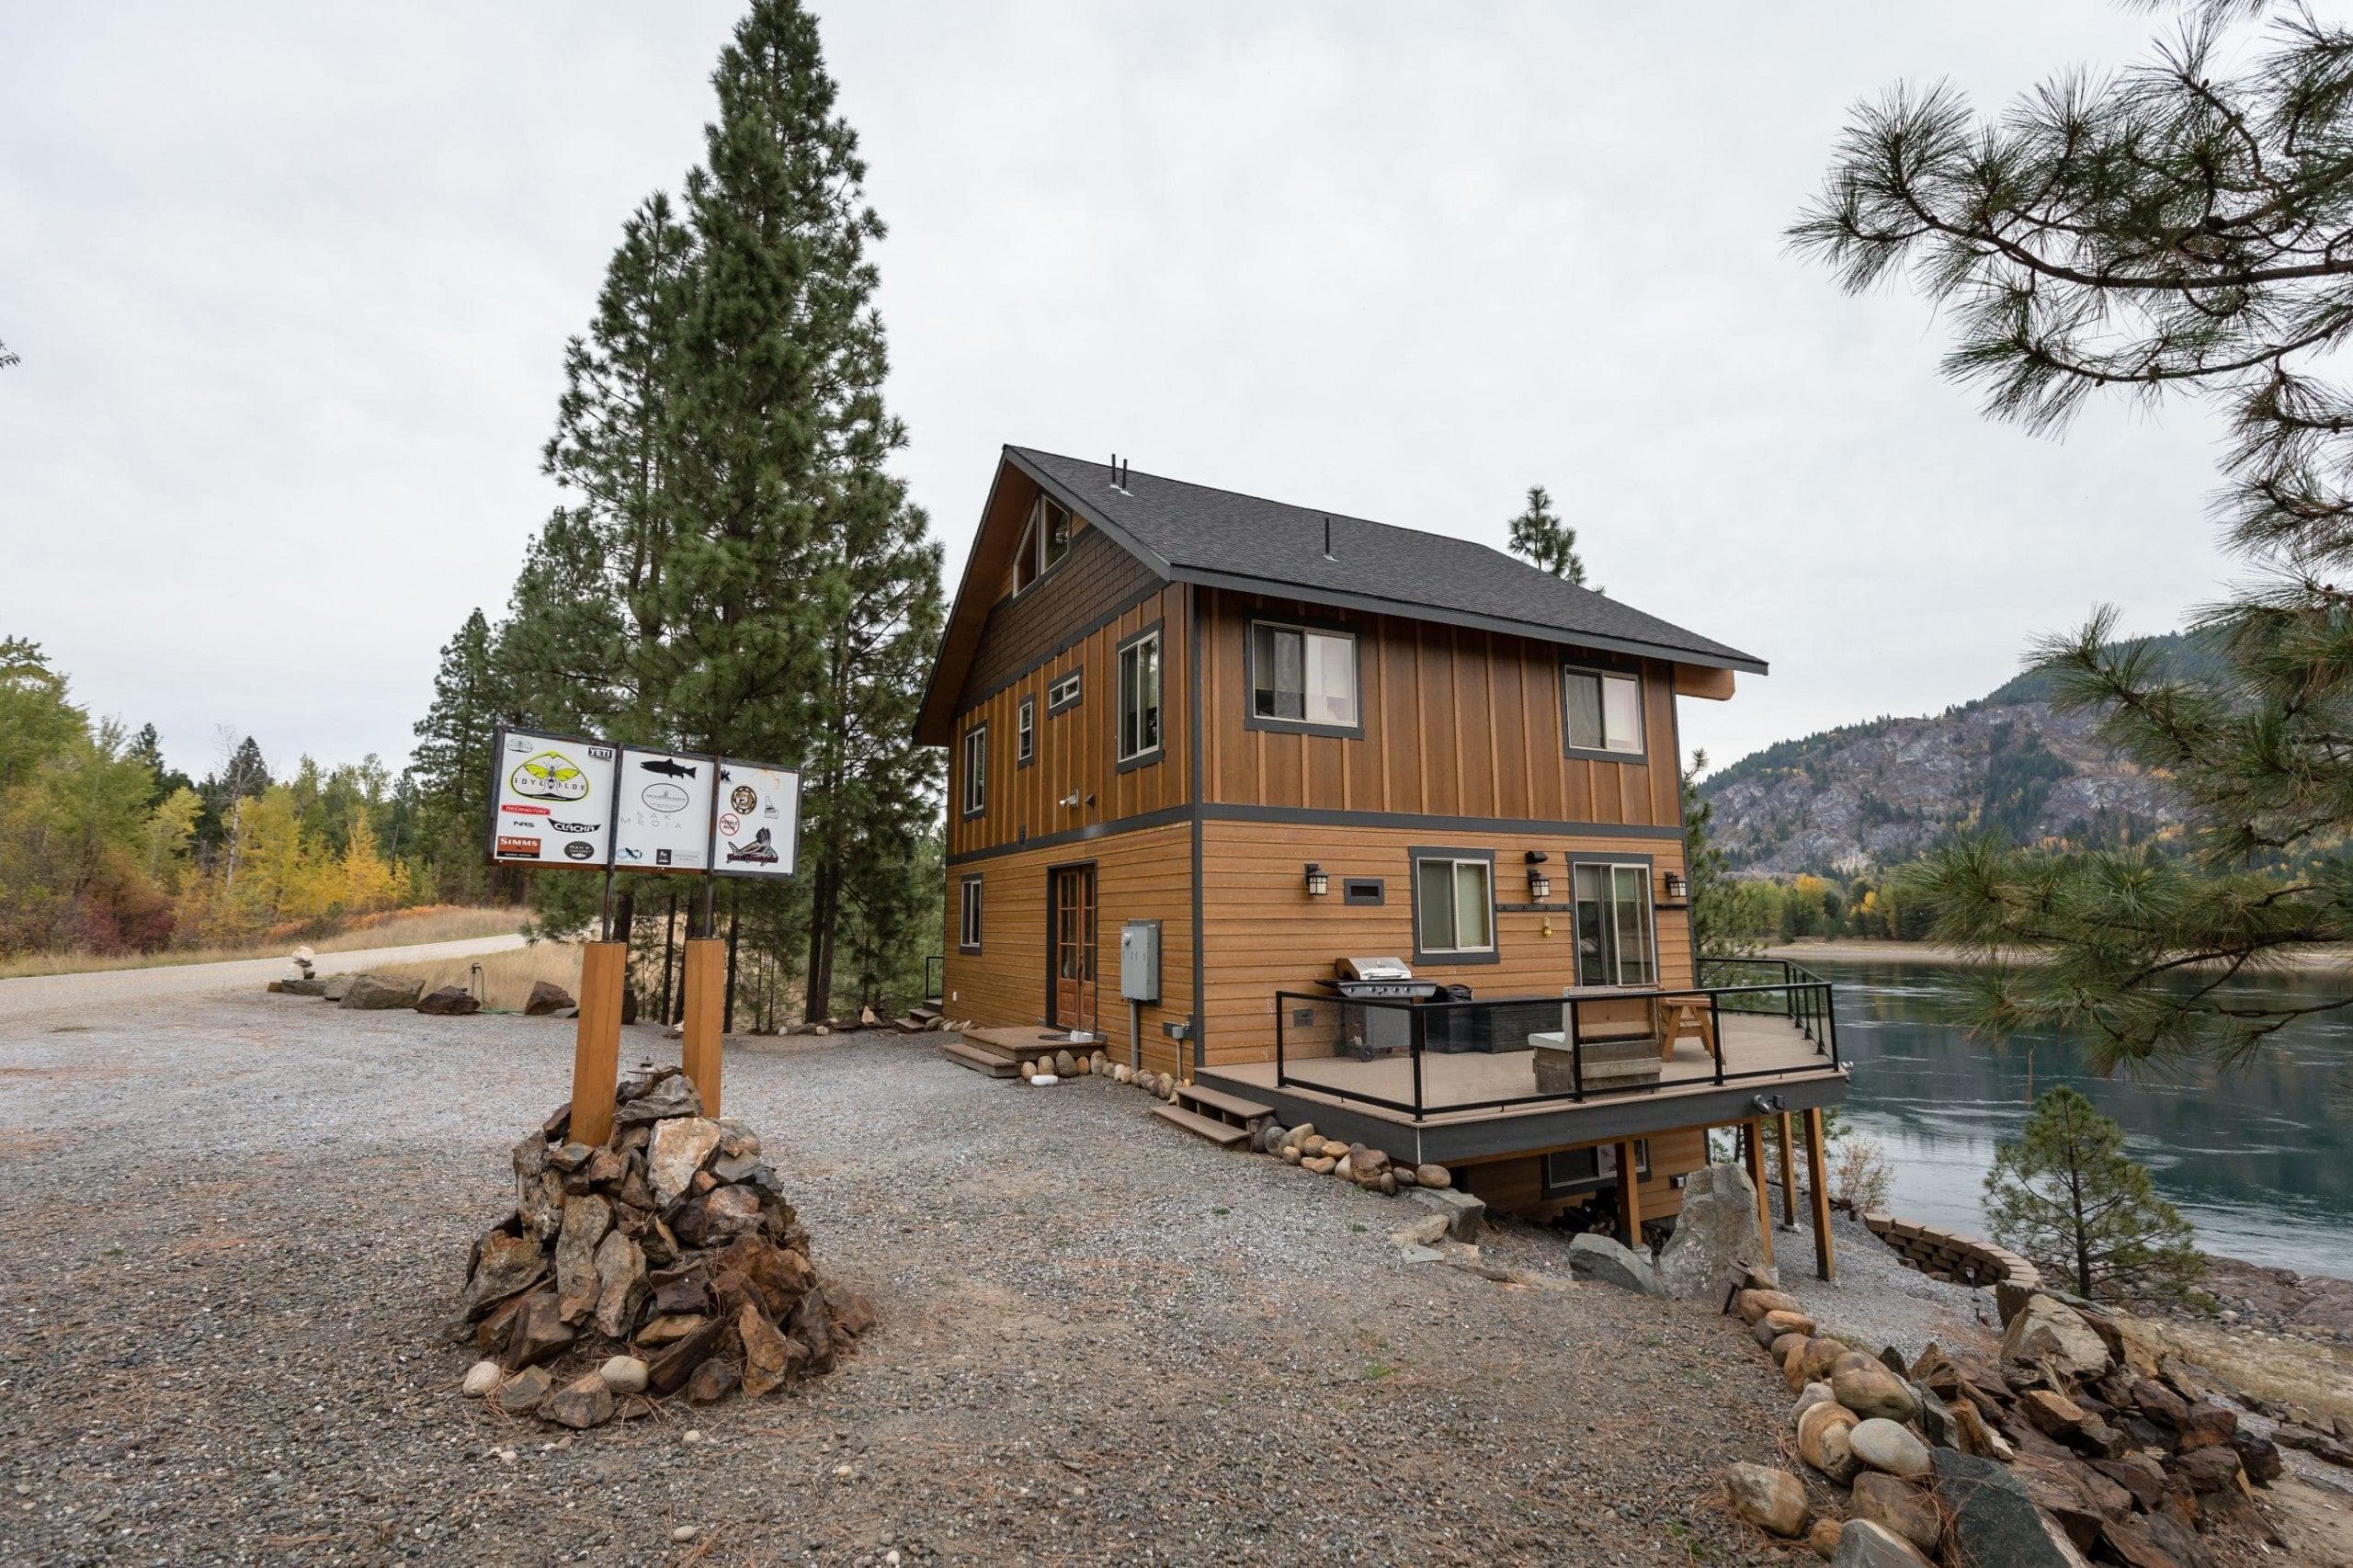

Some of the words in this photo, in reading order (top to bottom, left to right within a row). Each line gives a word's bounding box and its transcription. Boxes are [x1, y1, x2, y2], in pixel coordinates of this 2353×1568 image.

[589, 748, 611, 757] YETI
[553, 823, 595, 833] CLACKA
[499, 837, 539, 847] SIMMS
